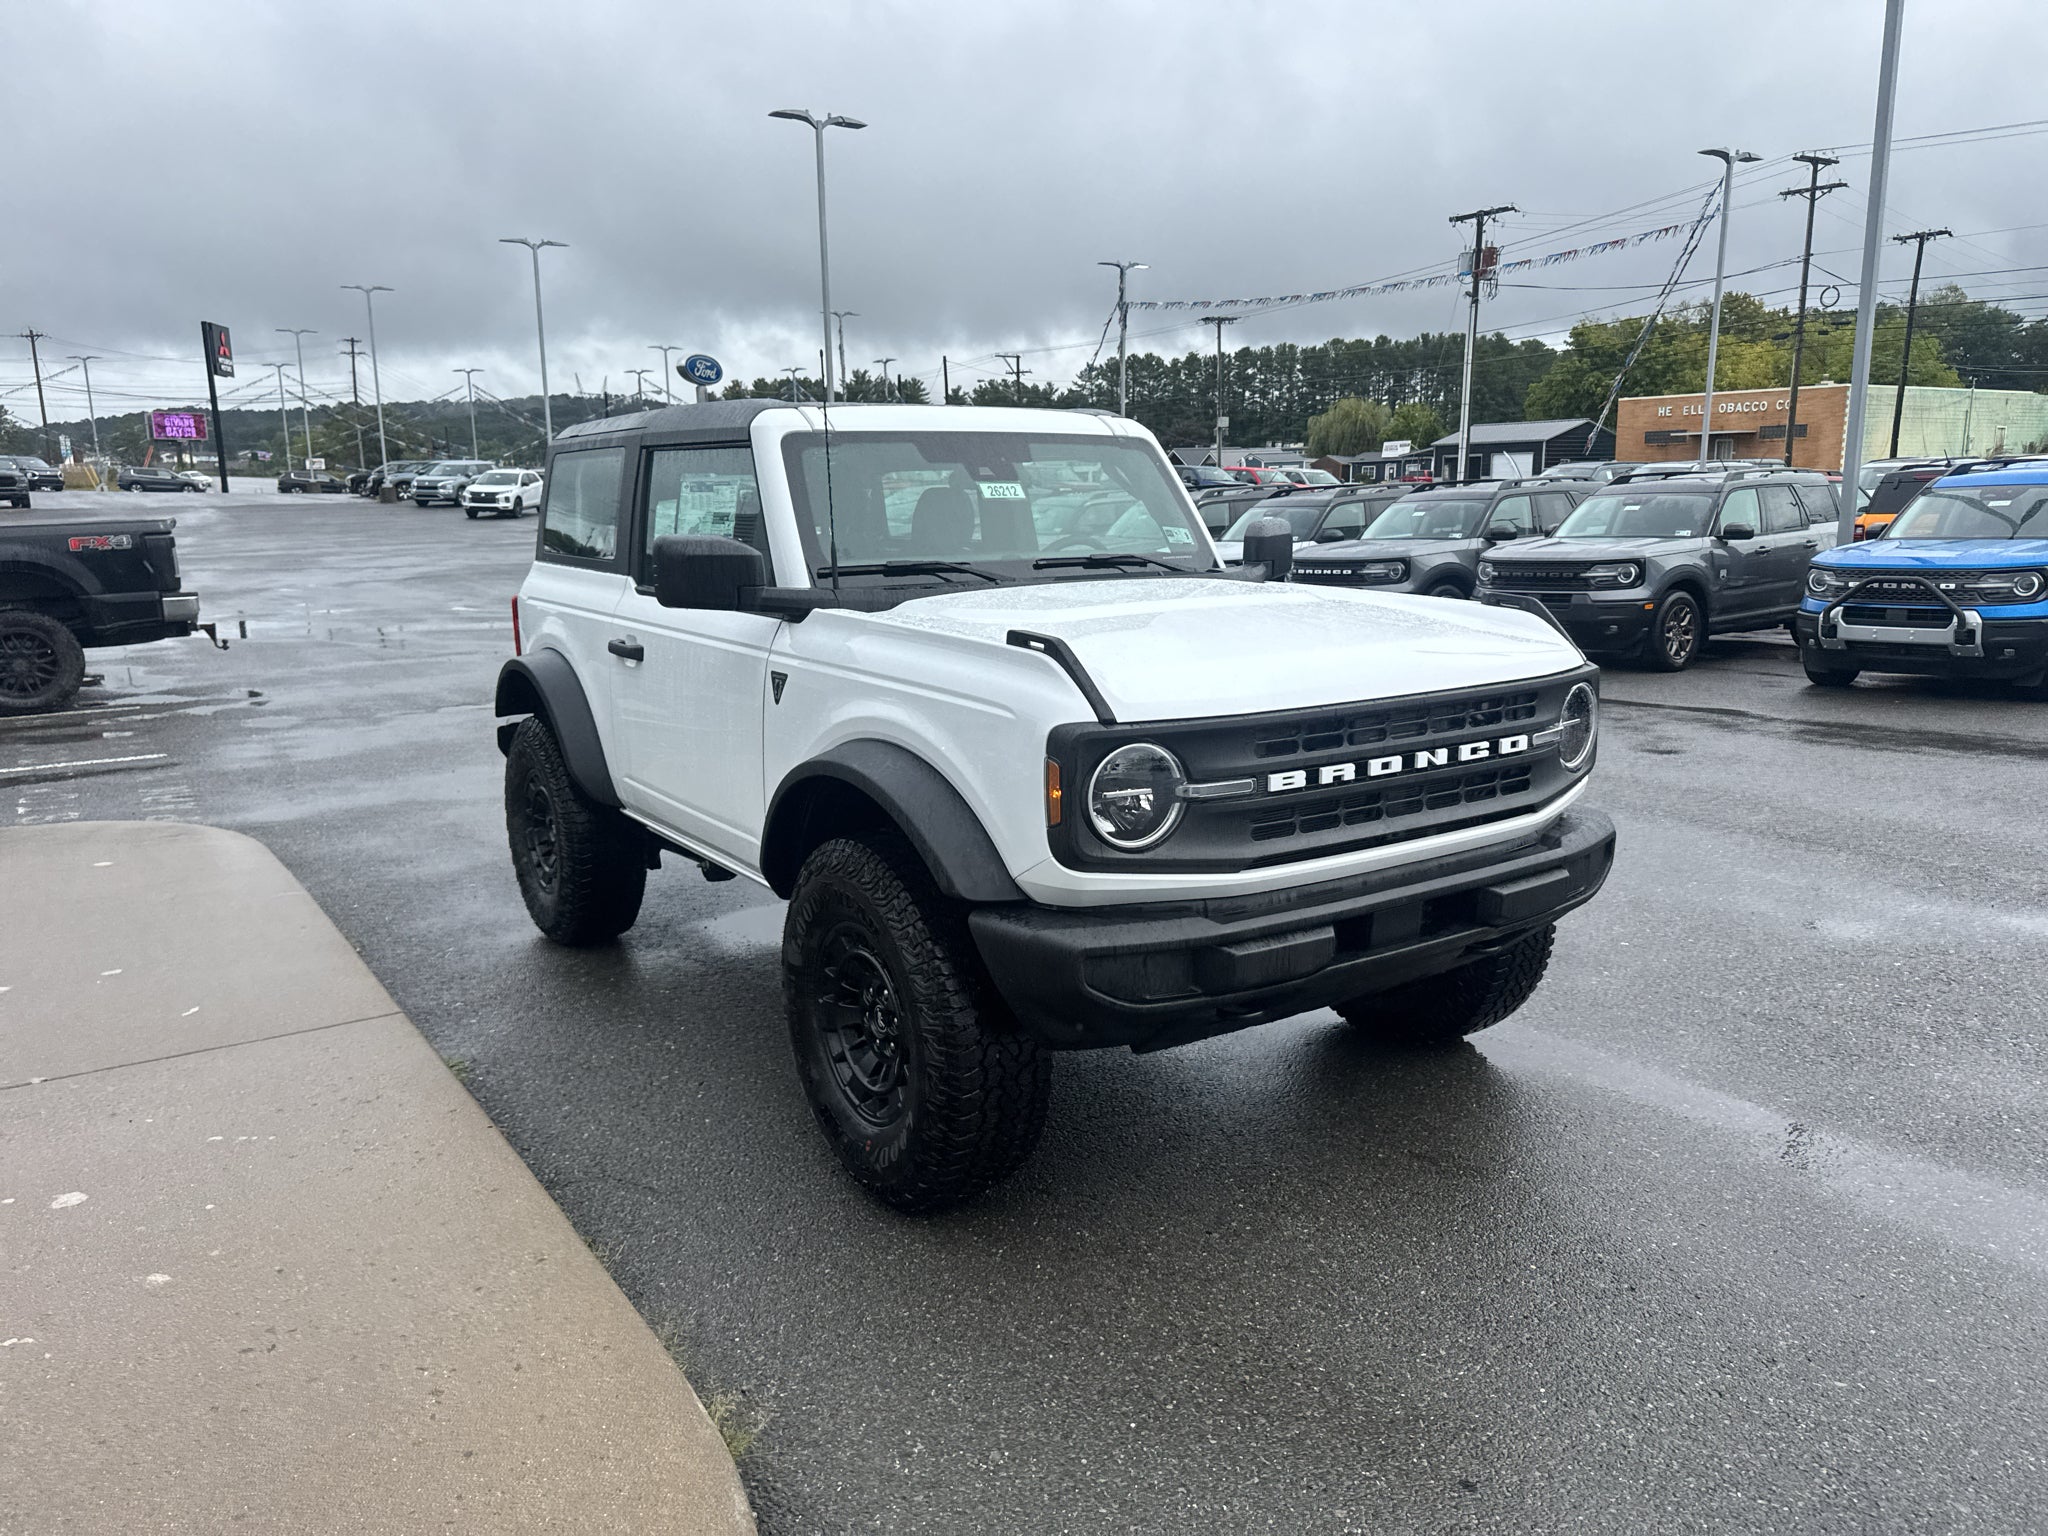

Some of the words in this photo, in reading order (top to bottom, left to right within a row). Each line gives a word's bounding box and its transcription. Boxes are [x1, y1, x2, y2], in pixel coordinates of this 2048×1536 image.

[694, 360, 717, 379] Ford
[1658, 406, 1673, 417] HE
[1718, 401, 1768, 413] OBACCO
[987, 485, 1019, 497] 26212
[68, 535, 132, 551] FX4
[1267, 734, 1529, 793] BRONCO
